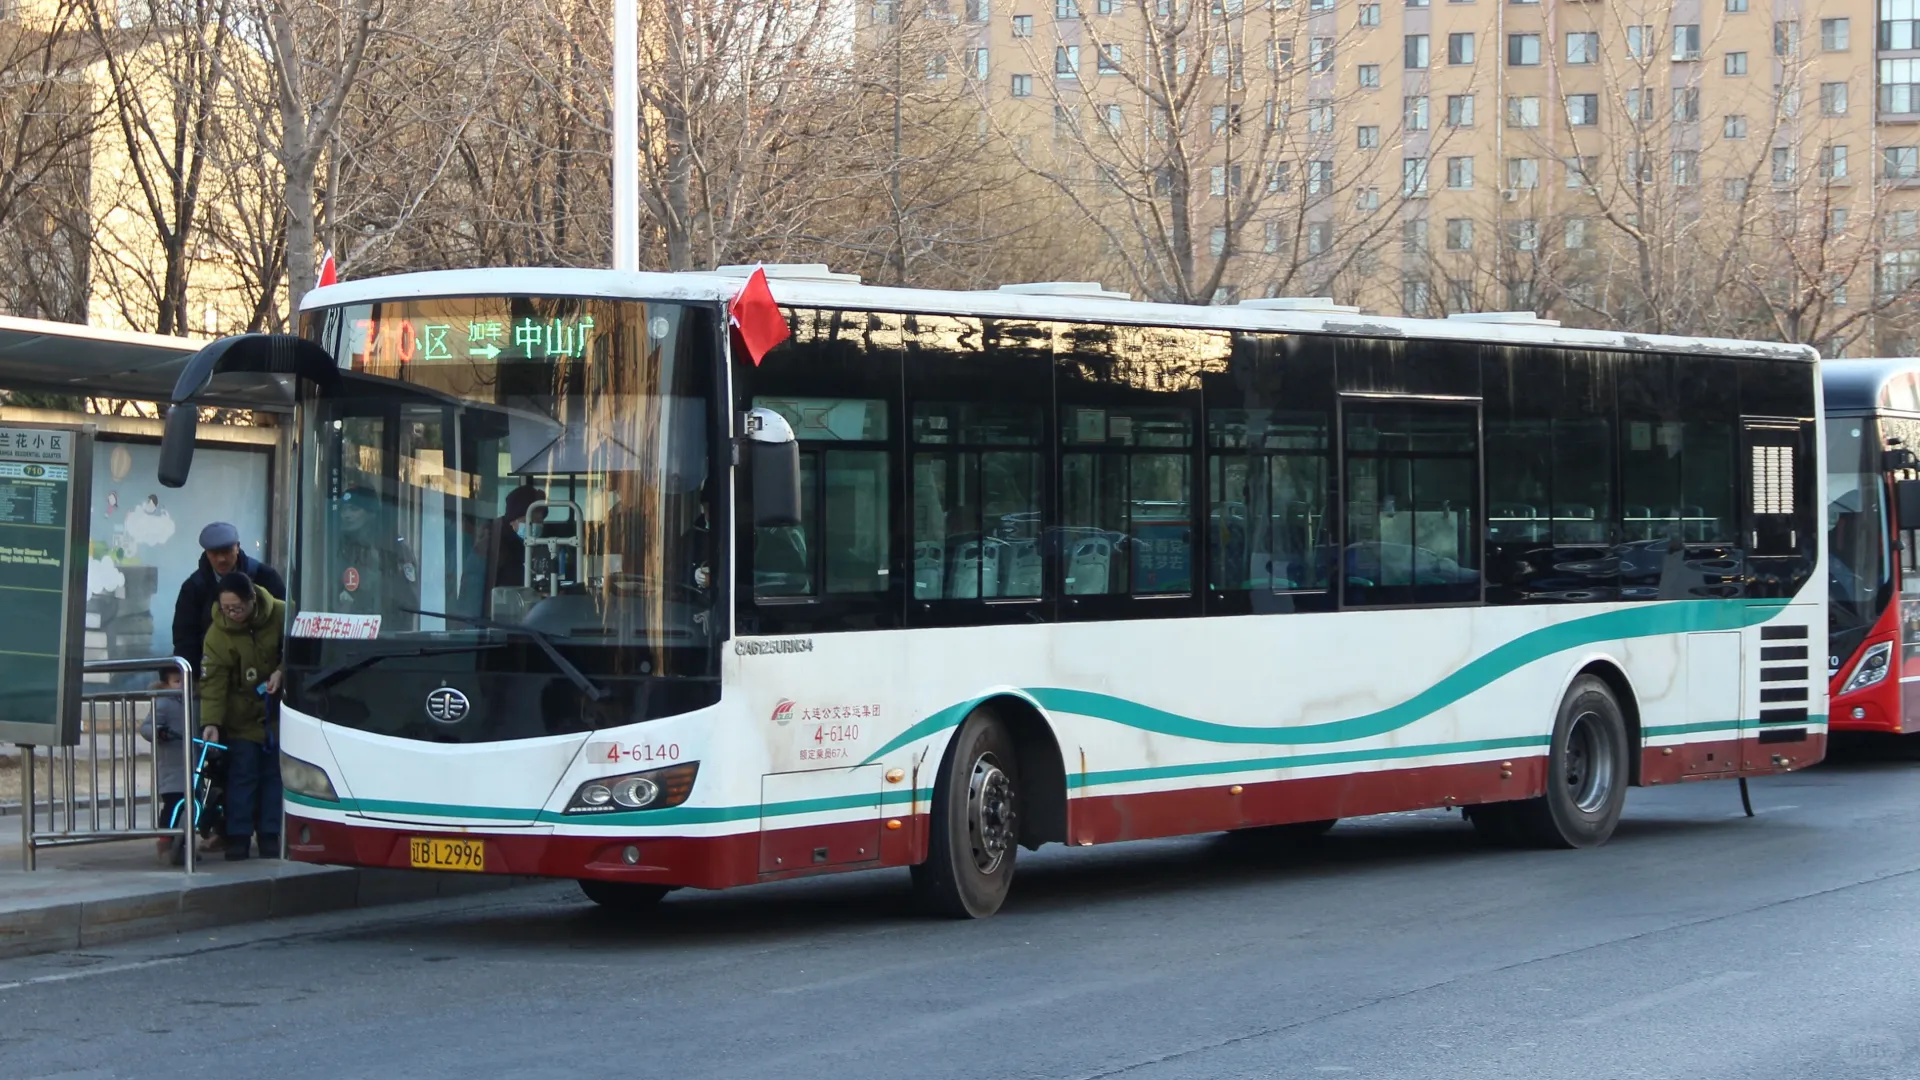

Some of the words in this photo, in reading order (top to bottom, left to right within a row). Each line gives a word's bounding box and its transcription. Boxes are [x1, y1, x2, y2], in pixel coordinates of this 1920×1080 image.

[356, 319, 416, 362] 710
[416, 324, 452, 360] 区
[27, 466, 43, 475] 710
[802, 704, 880, 721] 大连公交客运集团
[814, 724, 859, 744] 4-6140
[607, 743, 680, 763] 4-6140
